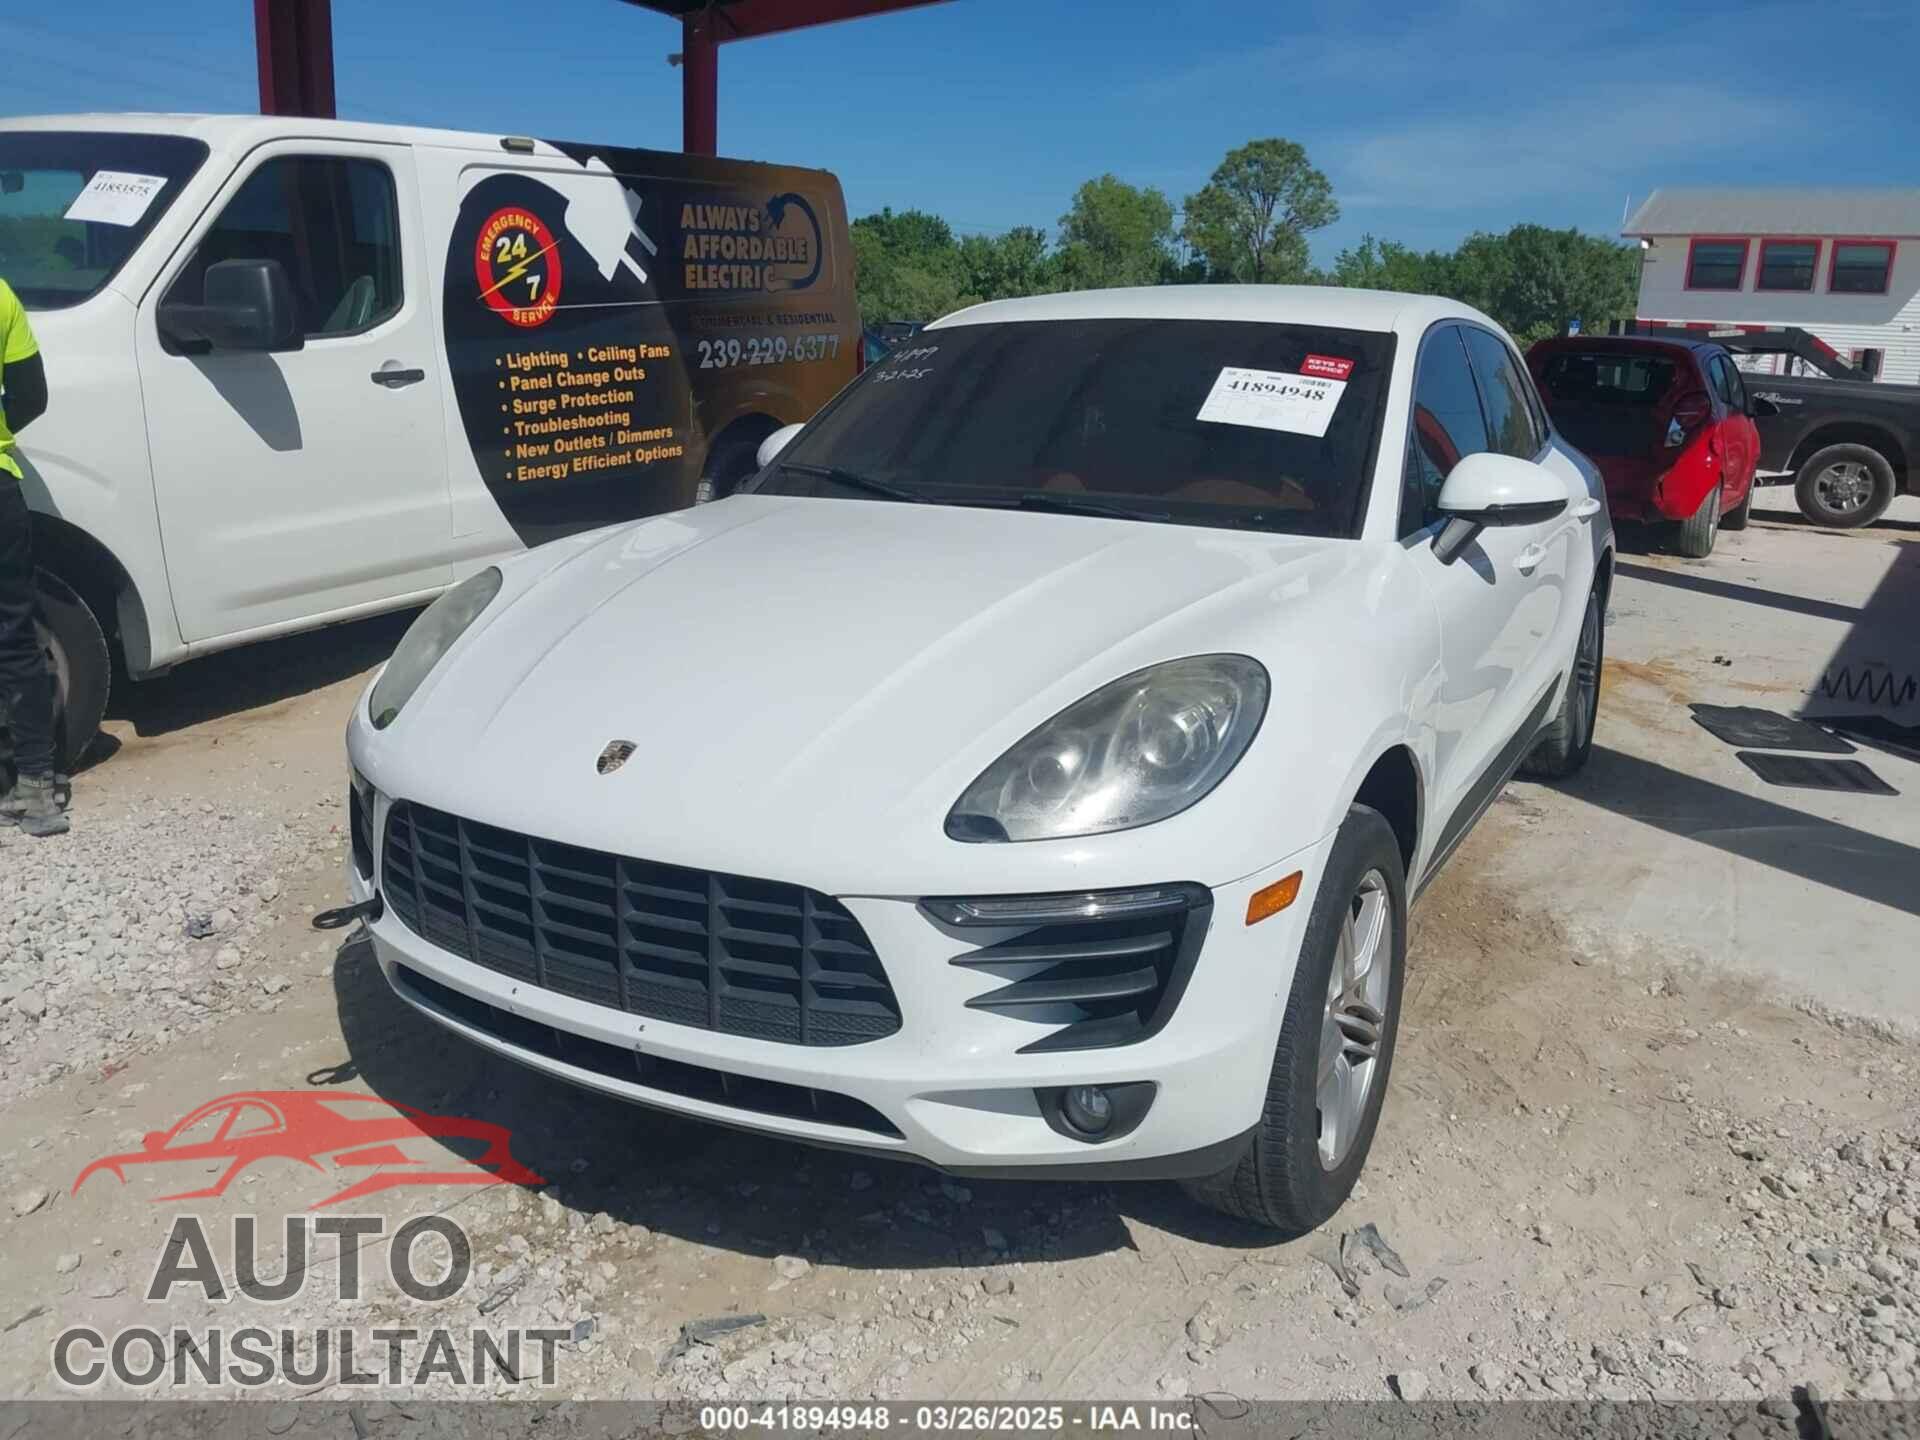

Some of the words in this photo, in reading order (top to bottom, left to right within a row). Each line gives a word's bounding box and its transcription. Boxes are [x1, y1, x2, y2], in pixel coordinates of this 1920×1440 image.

[681, 203, 761, 232] ALWAYS
[480, 214, 540, 262] EMERGENCY
[496, 233, 528, 264] 24
[683, 234, 808, 261] AFFORDABLE
[526, 275, 541, 301] 7
[776, 312, 837, 325] RESIDENTIAL
[506, 351, 569, 371] Lighting
[587, 347, 636, 362] Ceiling
[639, 344, 670, 359] Fans
[510, 374, 553, 391] Panel
[556, 371, 610, 387] Change
[614, 367, 646, 382] Outs
[1228, 379, 1326, 400] 41894948
[512, 398, 557, 415] Surge
[560, 389, 634, 409] Protection
[514, 411, 631, 436] Troubleshooting
[516, 443, 550, 459] New
[554, 435, 606, 453] Outlets
[617, 426, 673, 445] Dimmers
[517, 462, 568, 481] Energy
[572, 452, 632, 472] Efficient
[635, 445, 683, 464] Options
